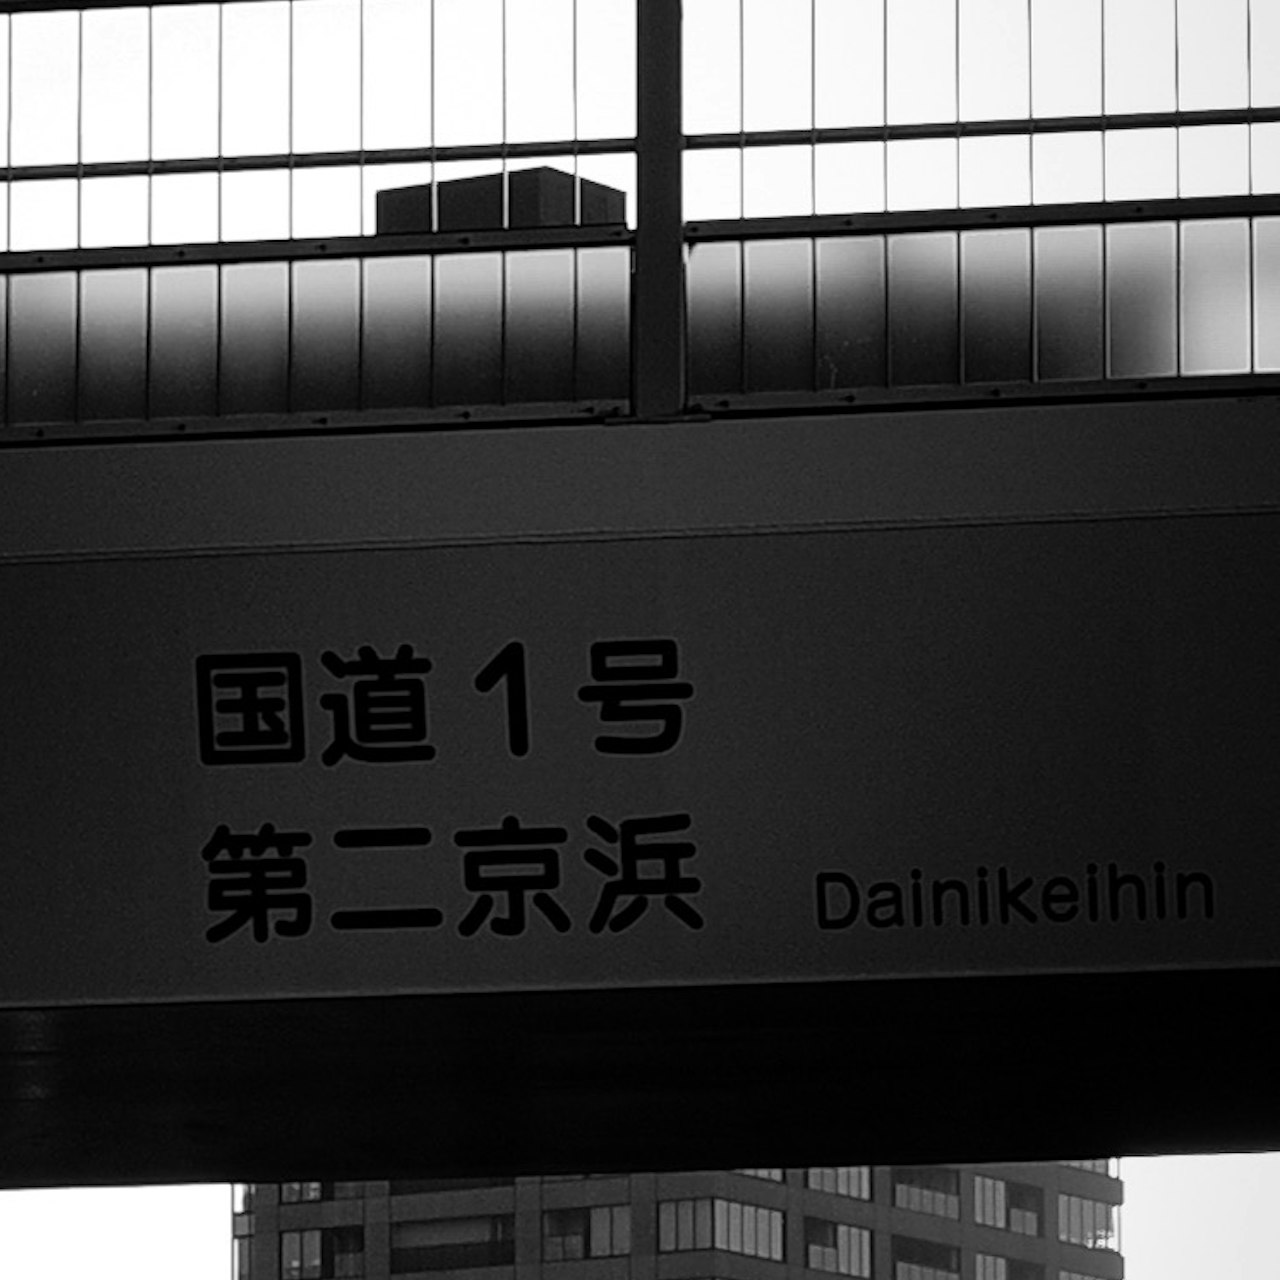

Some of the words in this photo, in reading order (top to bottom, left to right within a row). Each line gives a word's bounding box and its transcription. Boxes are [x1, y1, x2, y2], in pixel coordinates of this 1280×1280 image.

[195, 639, 692, 765] 国道1号
[204, 814, 703, 942] 第二京浜
[816, 862, 1214, 930] Dainikeihin
